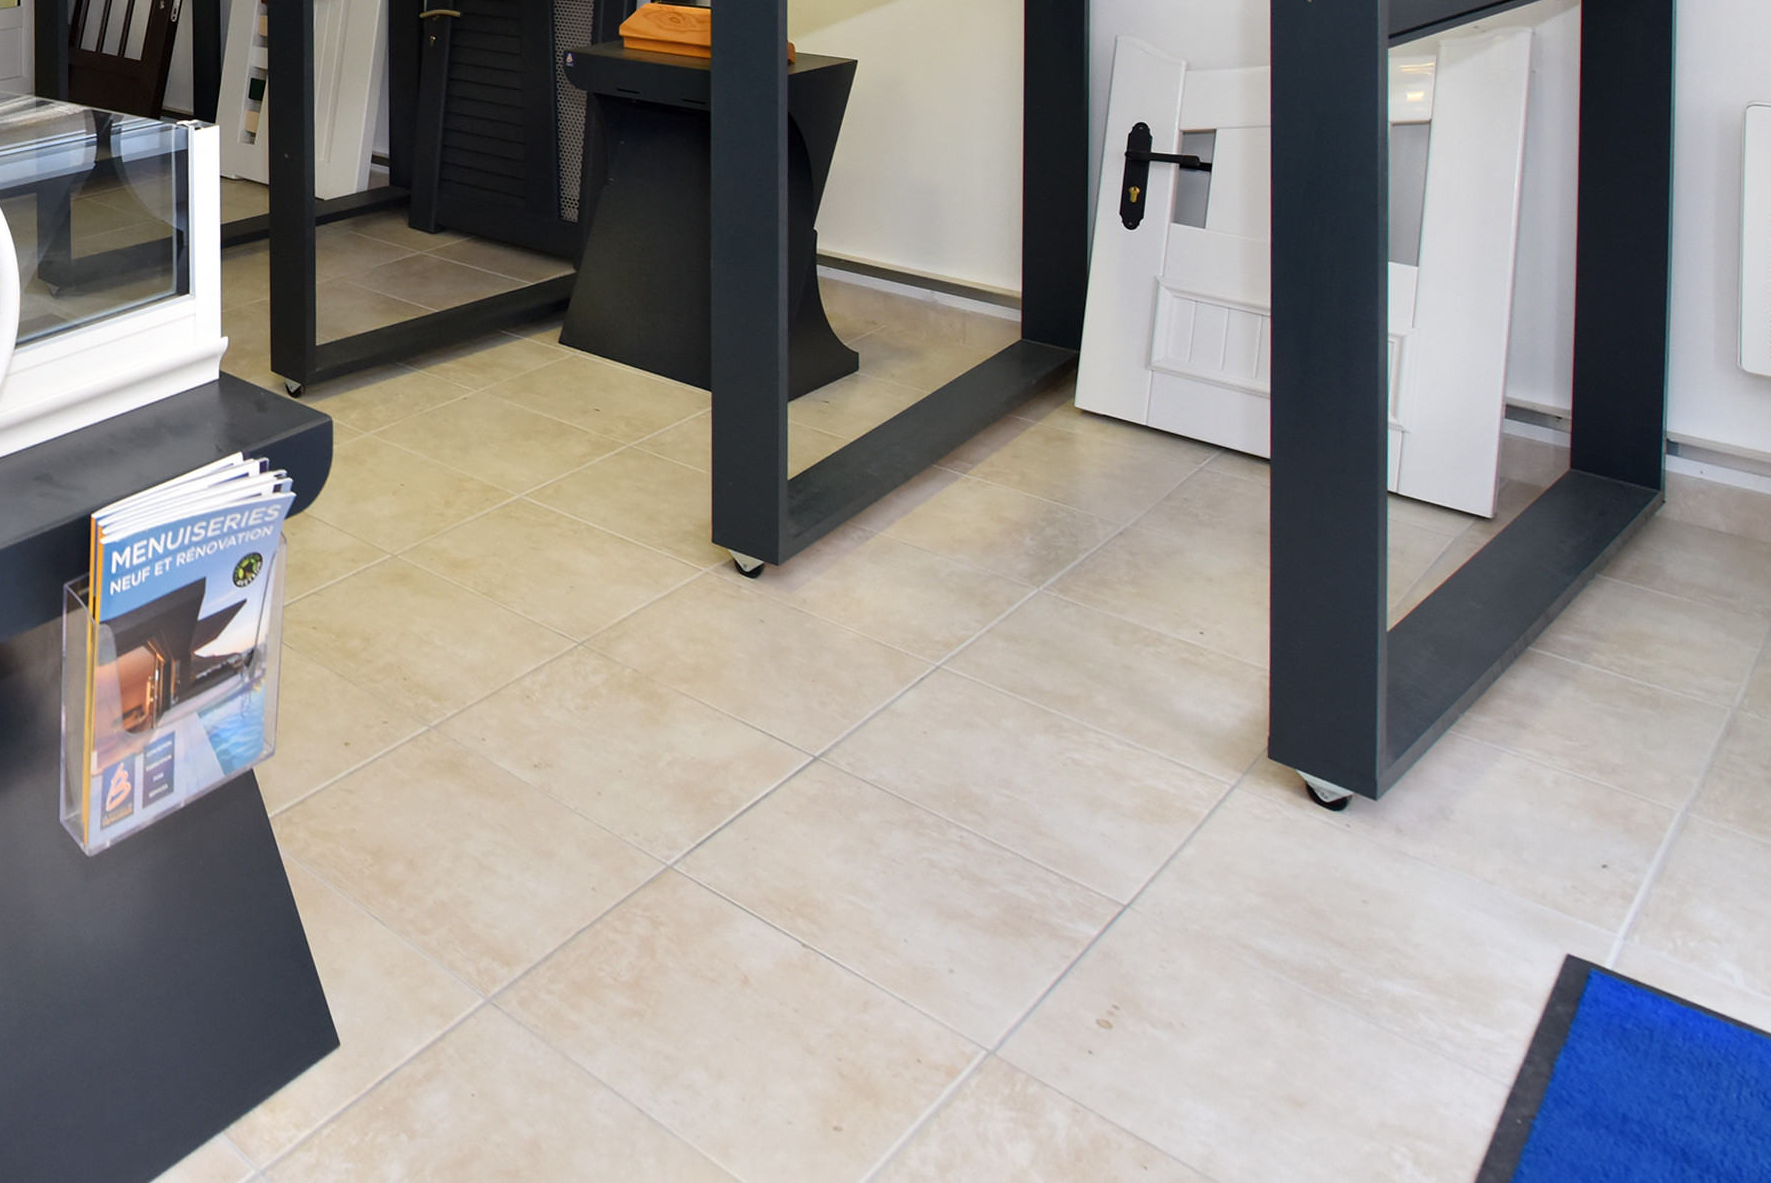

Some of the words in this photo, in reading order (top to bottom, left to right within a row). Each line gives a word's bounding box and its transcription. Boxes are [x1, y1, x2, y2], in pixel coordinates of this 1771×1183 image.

[109, 568, 150, 595] NEUF
[154, 557, 173, 576] ET
[176, 526, 274, 566] RÉNOVATION
[110, 504, 282, 574] MENUISERIES
